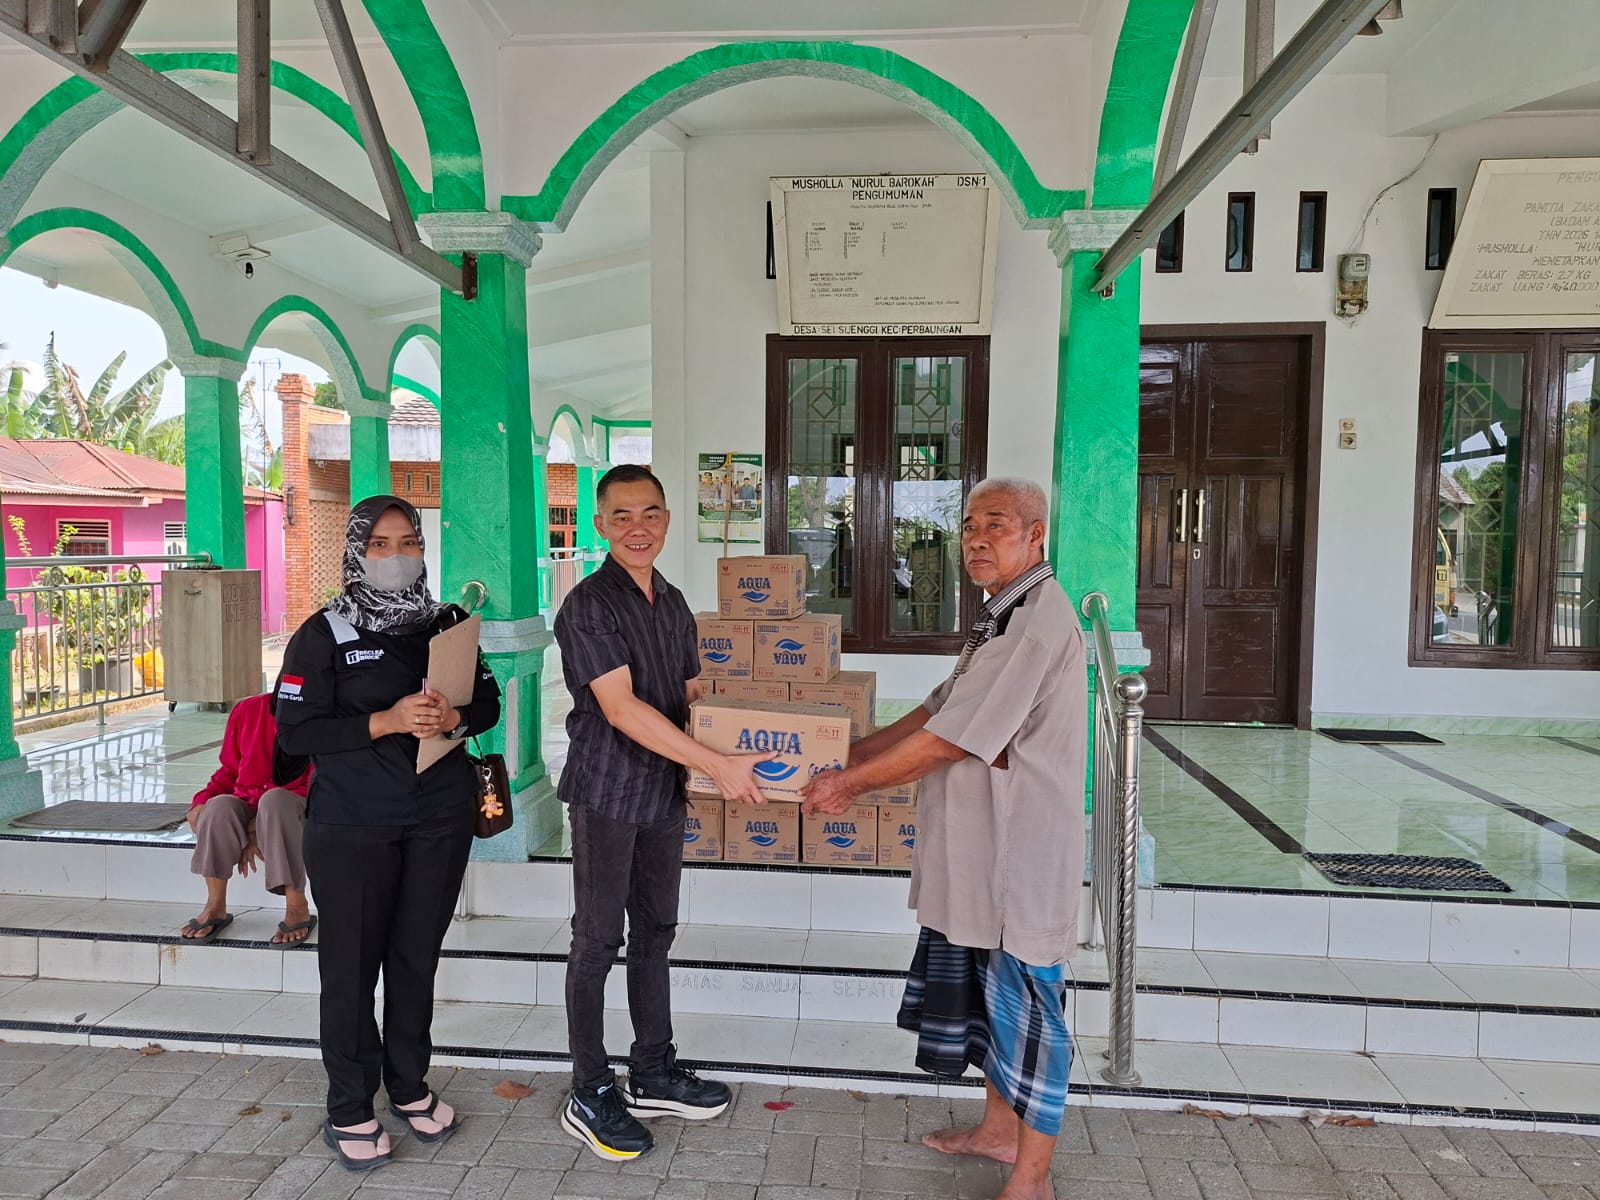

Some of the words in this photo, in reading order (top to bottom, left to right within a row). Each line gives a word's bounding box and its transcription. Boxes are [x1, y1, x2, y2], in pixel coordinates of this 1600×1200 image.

[791, 178, 844, 190] MUSHOLLA
[852, 190, 924, 201] PENGUMUMAN
[1473, 270, 1508, 281] ZAKAT
[1469, 282, 1504, 293] ZAKAT
[736, 577, 772, 592] AQUA
[699, 637, 734, 652] AQUA
[773, 649, 808, 666] AQUA
[735, 727, 803, 757] AQUA
[685, 817, 703, 832] UA
[744, 820, 780, 836] AQUA
[822, 821, 858, 837] AQUA
